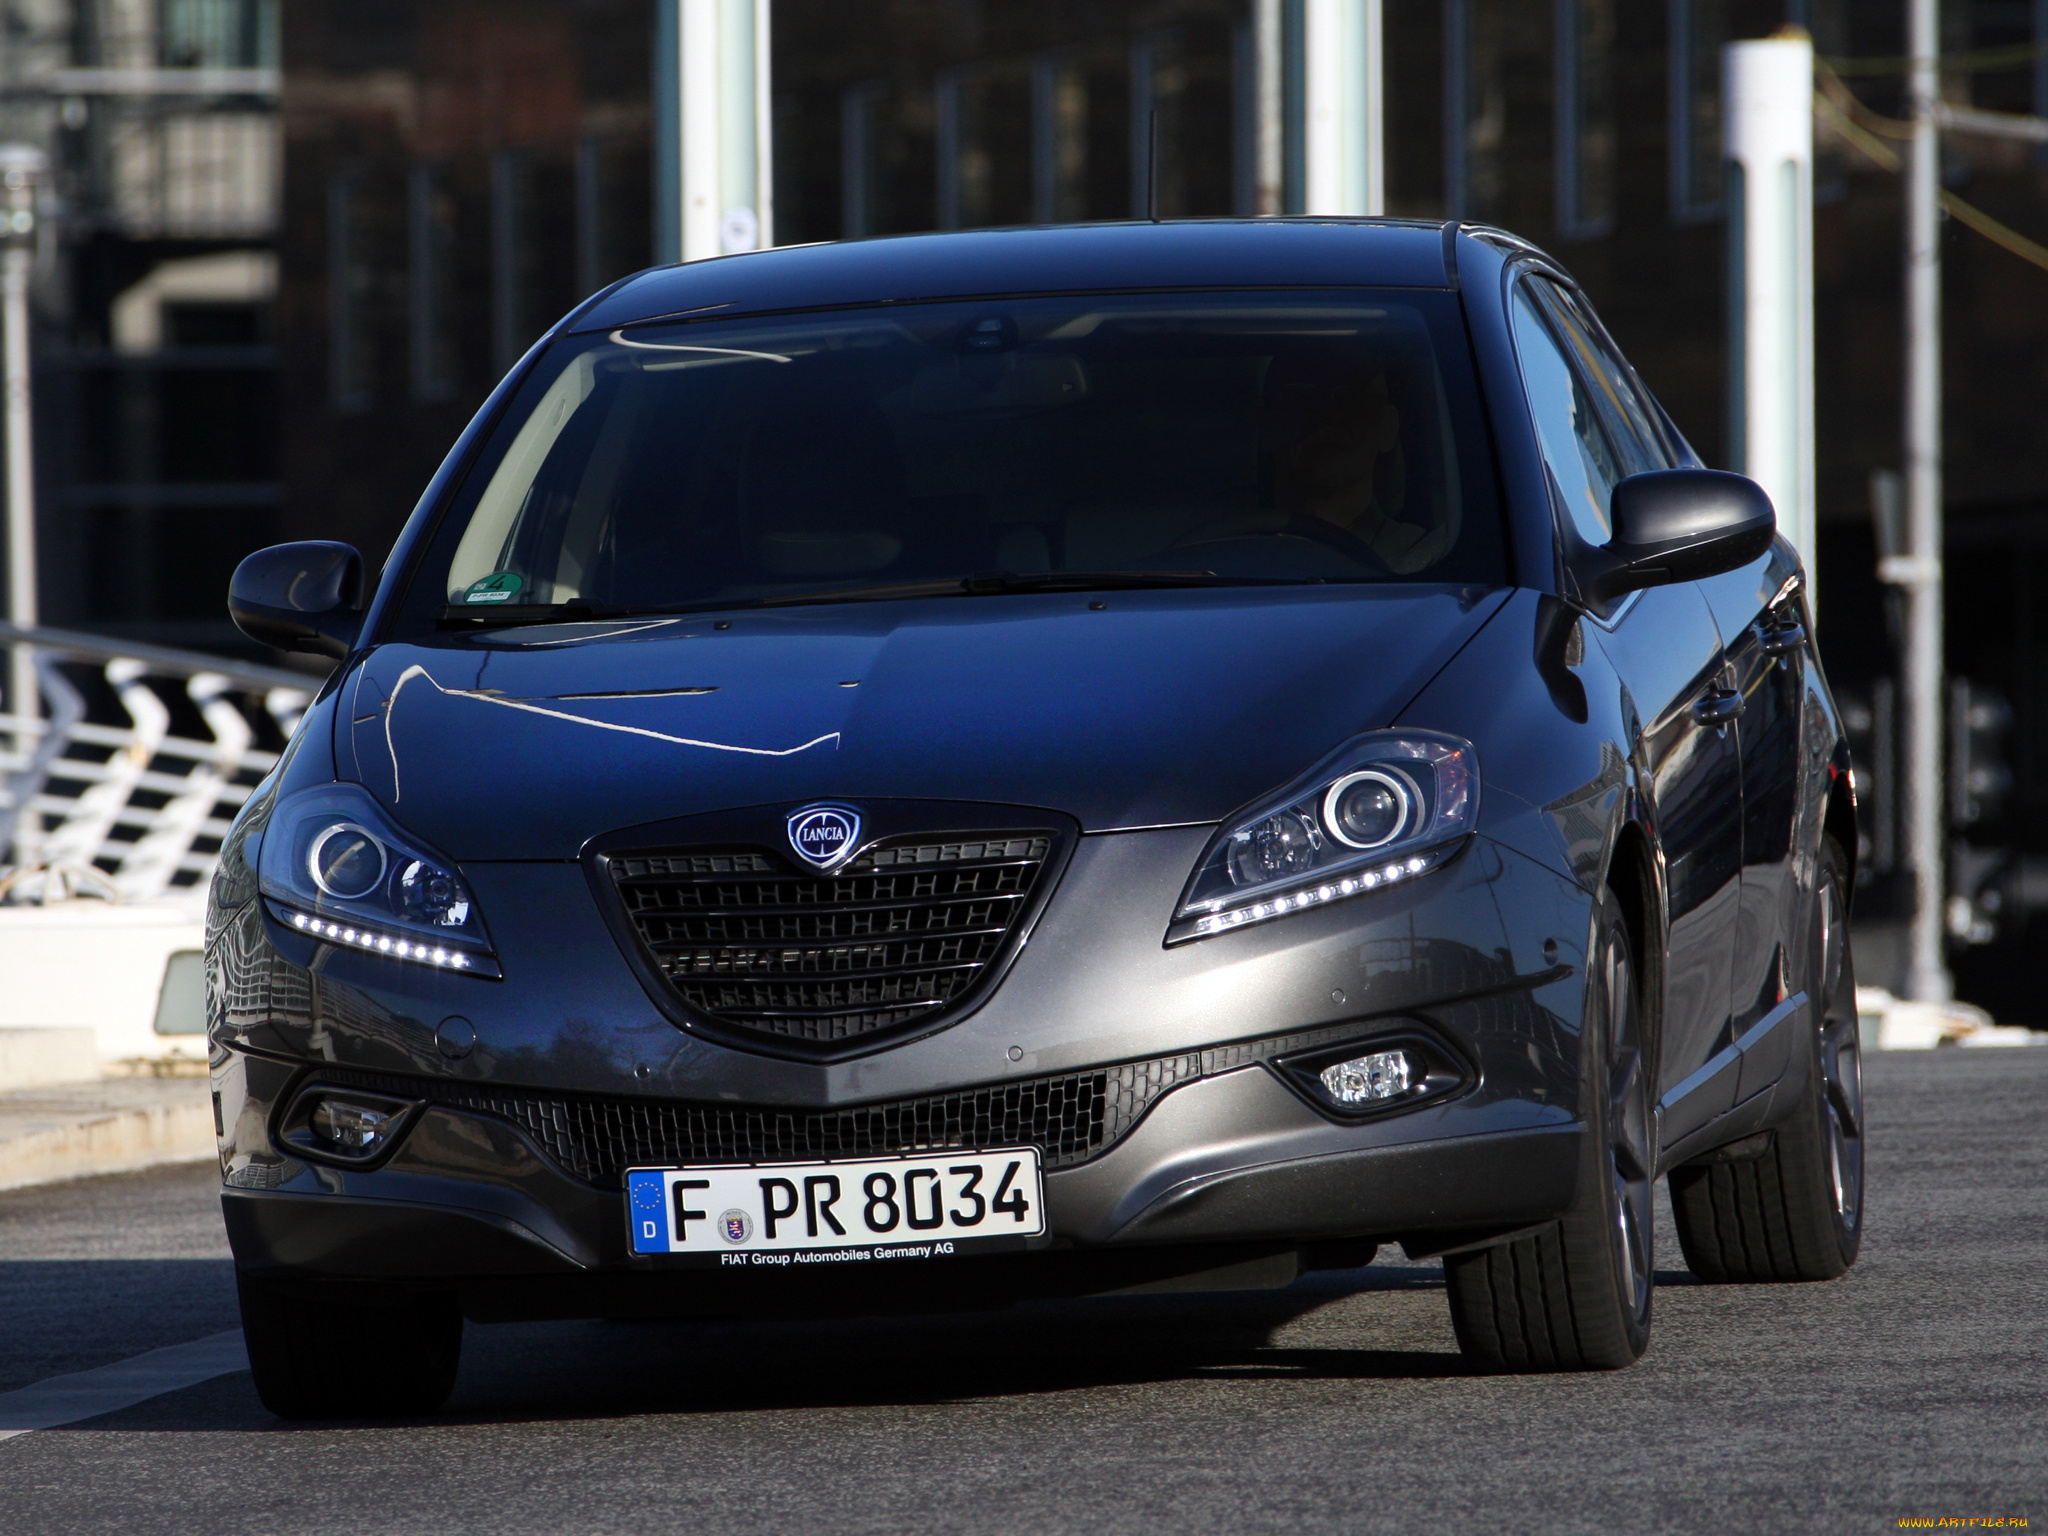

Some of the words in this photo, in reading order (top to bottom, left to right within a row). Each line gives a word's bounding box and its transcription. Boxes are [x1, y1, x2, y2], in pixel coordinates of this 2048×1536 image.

[487, 575, 506, 590] 4
[803, 827, 844, 841] LANCIA
[672, 1179, 710, 1242] F
[758, 1174, 847, 1239] PR
[863, 1161, 1030, 1234] 8034
[643, 1221, 657, 1239] D
[721, 1253, 748, 1265] FIAT
[751, 1253, 790, 1266] Group
[793, 1249, 871, 1264] Automobiles
[873, 1246, 931, 1259] Germany
[934, 1242, 954, 1255] AG
